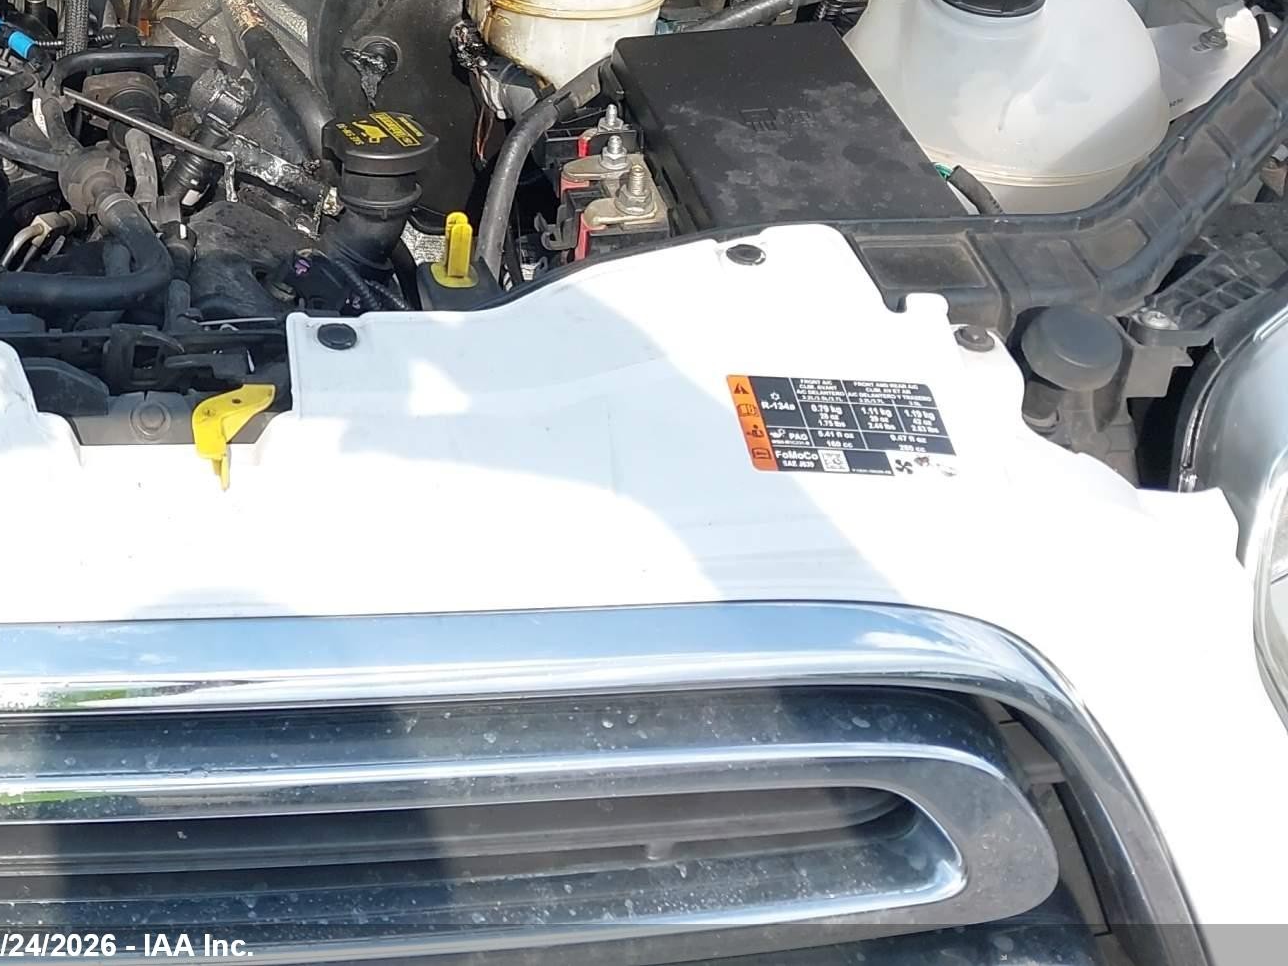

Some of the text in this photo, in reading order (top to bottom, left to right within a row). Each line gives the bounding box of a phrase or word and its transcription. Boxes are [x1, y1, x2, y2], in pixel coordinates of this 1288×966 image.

[761, 401, 796, 410] R-134a
[830, 404, 842, 415] kg
[775, 451, 818, 460] FoMoCo
